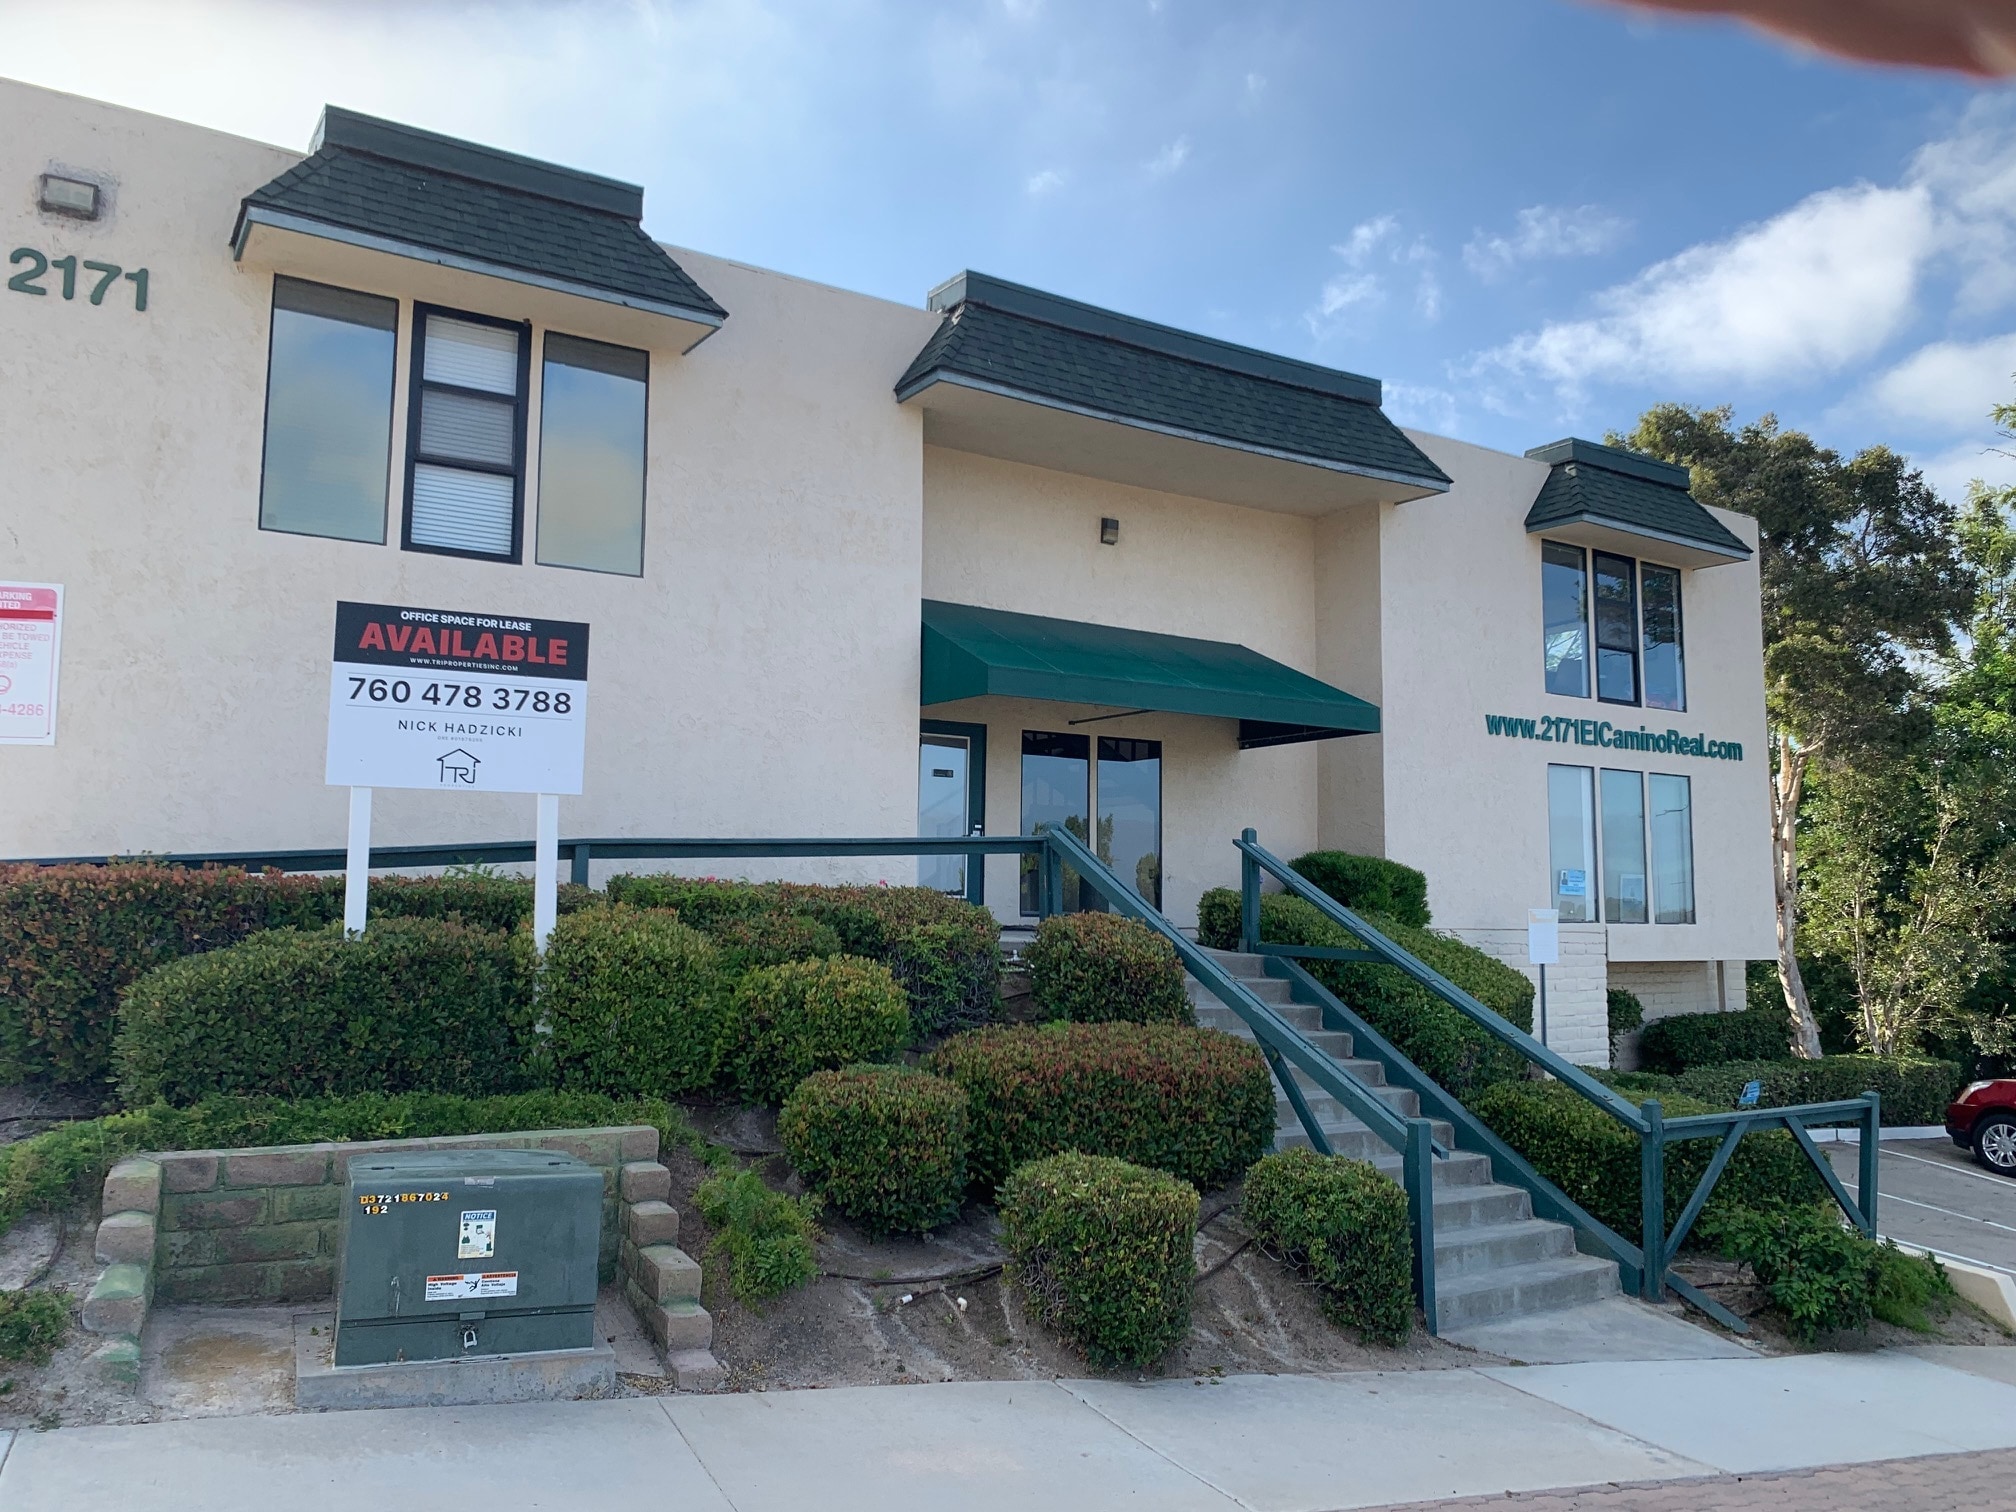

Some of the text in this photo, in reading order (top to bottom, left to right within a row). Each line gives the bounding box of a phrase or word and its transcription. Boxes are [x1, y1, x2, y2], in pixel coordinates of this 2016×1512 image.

[8, 247, 148, 312] 2171
[401, 611, 532, 632] OFFICE SPACE FOR LEASE
[359, 622, 568, 666] AVAILABLE
[410, 657, 519, 671] WWW.TRIPROPERTIESINC.COM
[349, 677, 571, 714] 760 478 3788
[0, 703, 44, 716] -4286
[398, 720, 522, 737] NICK HADZICKI
[1485, 714, 1743, 761] www.2171ElCaminoReal.com
[365, 1205, 388, 1214] 192
[464, 1212, 493, 1220] NOTICE
